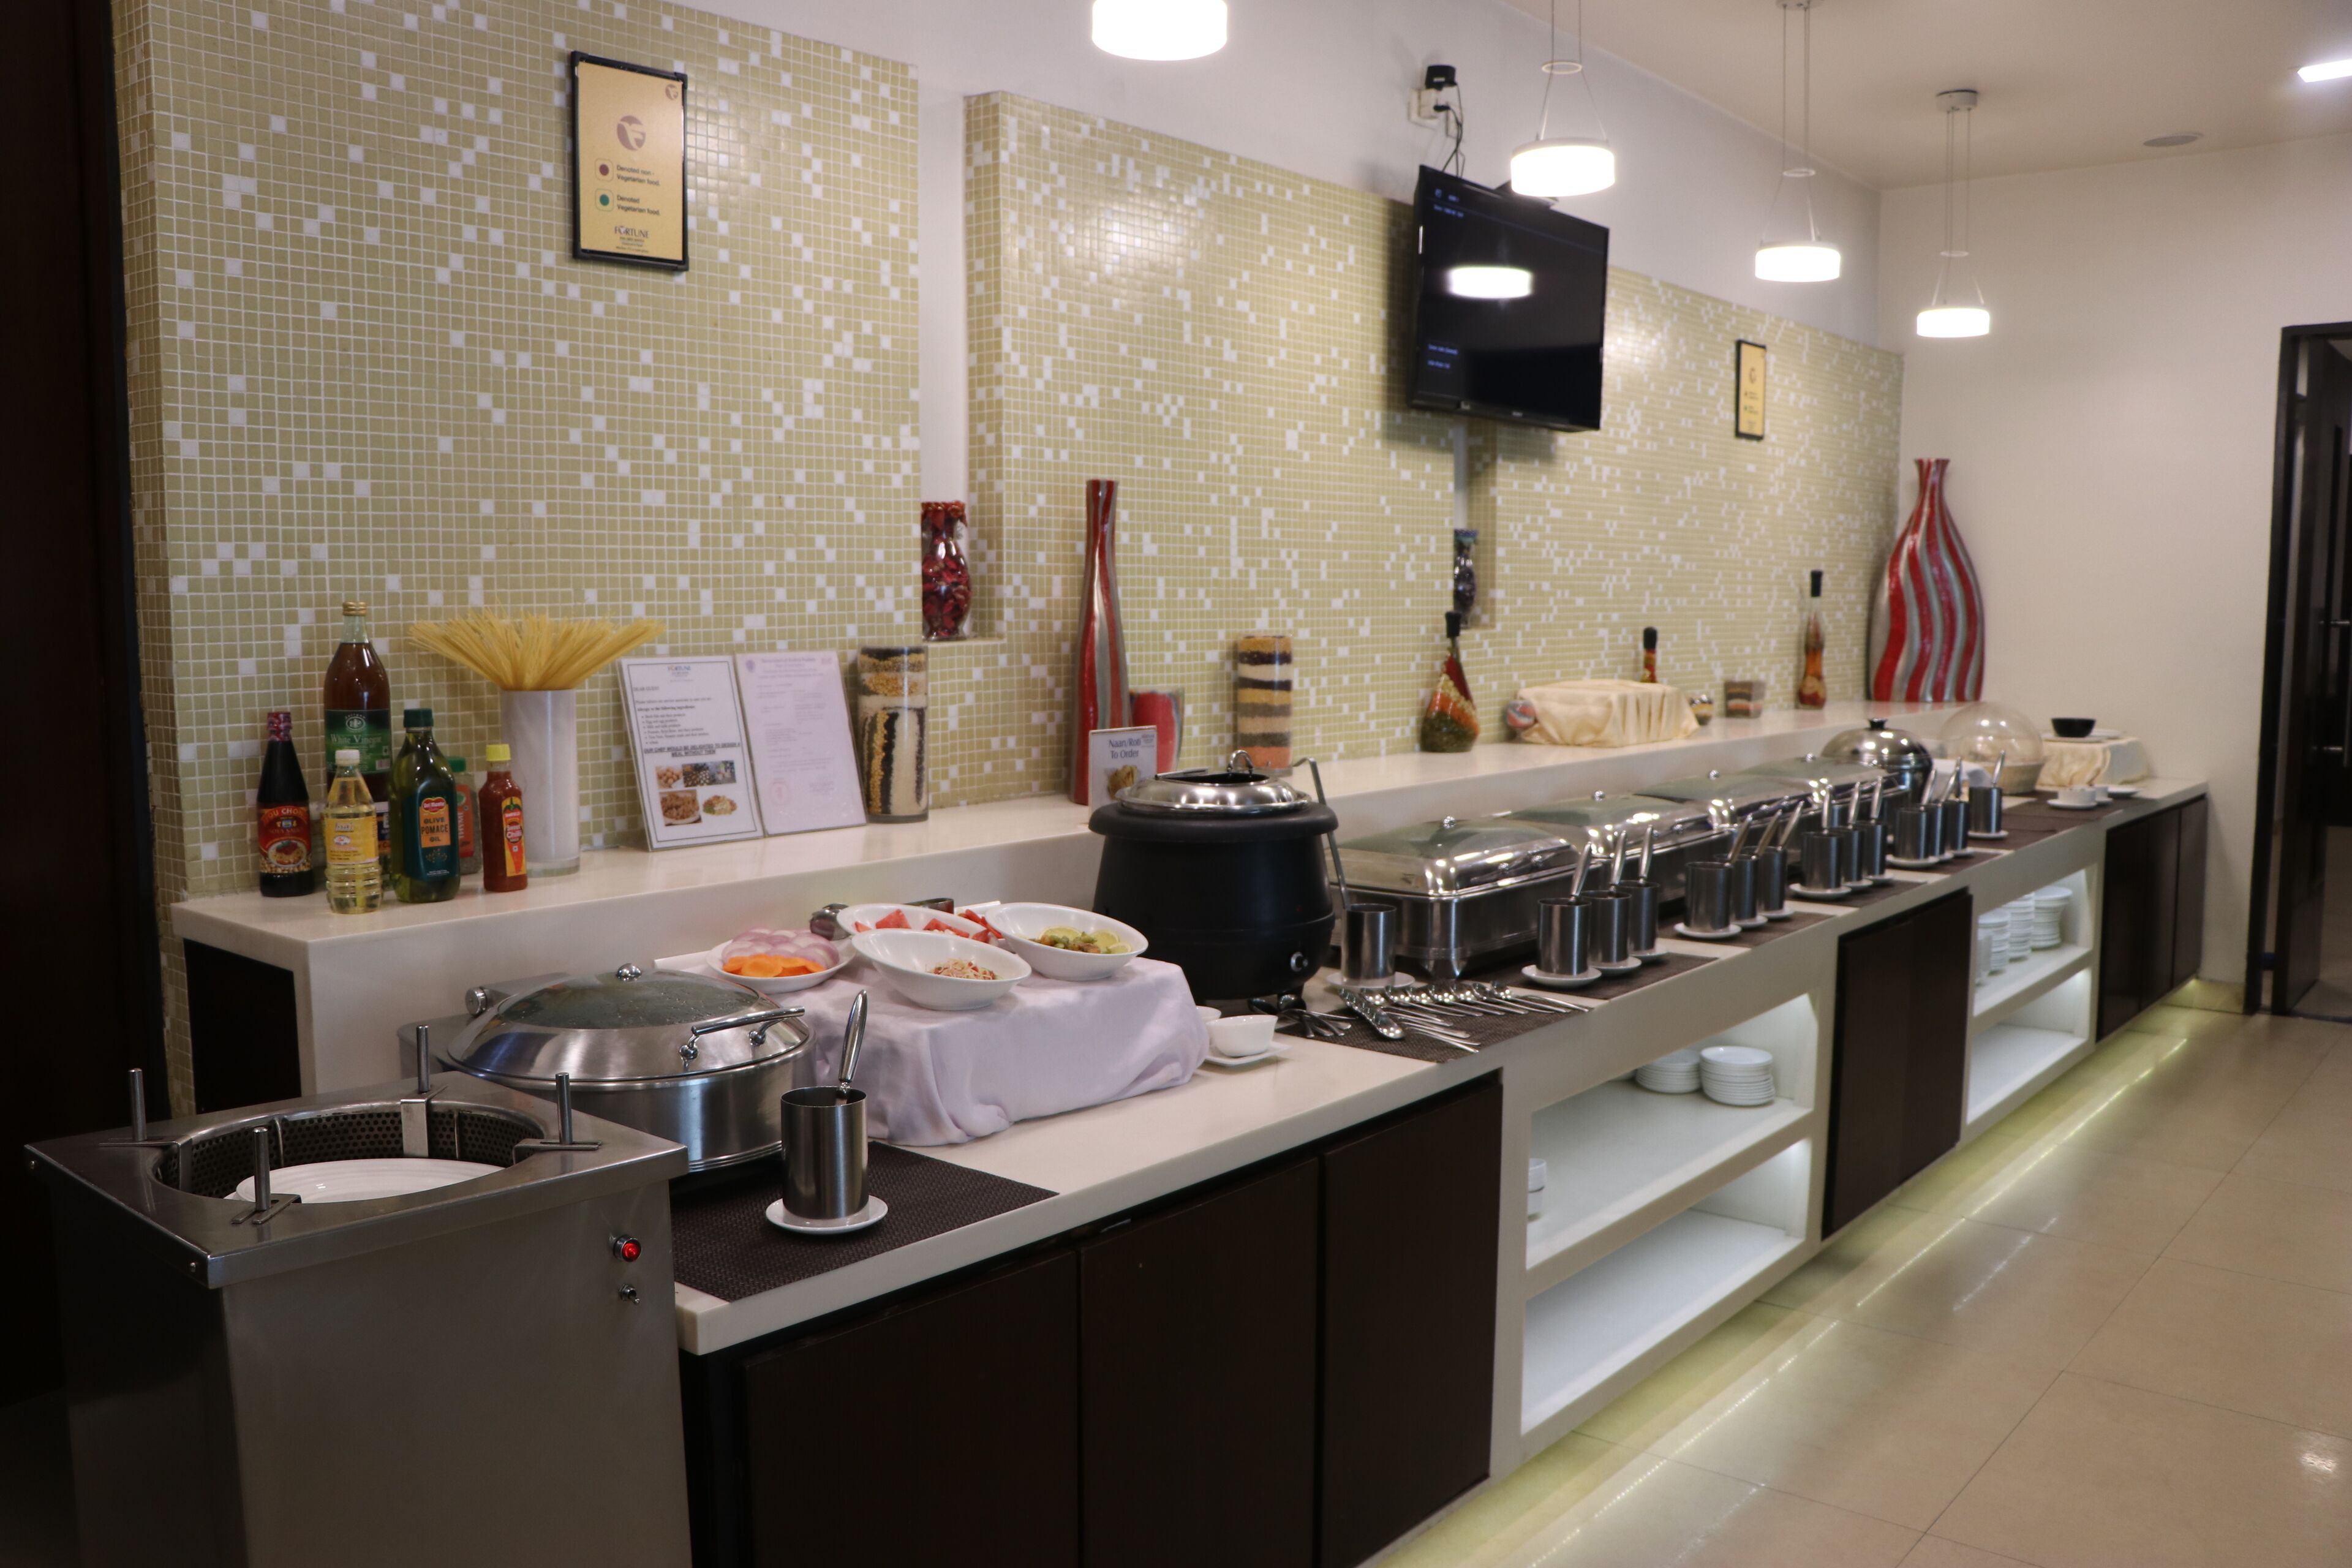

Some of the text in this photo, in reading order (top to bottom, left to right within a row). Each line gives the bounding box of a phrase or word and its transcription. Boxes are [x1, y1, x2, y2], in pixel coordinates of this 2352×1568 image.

[617, 165, 639, 173] Denoted
[617, 174, 646, 183] Vegetarian
[617, 194, 639, 203] Denoted
[617, 204, 646, 213] Vegetarian
[614, 225, 649, 238] FORTUNE
[331, 734, 351, 744] White
[1110, 748, 1139, 759] To Order
[421, 824, 448, 834] POMACE
